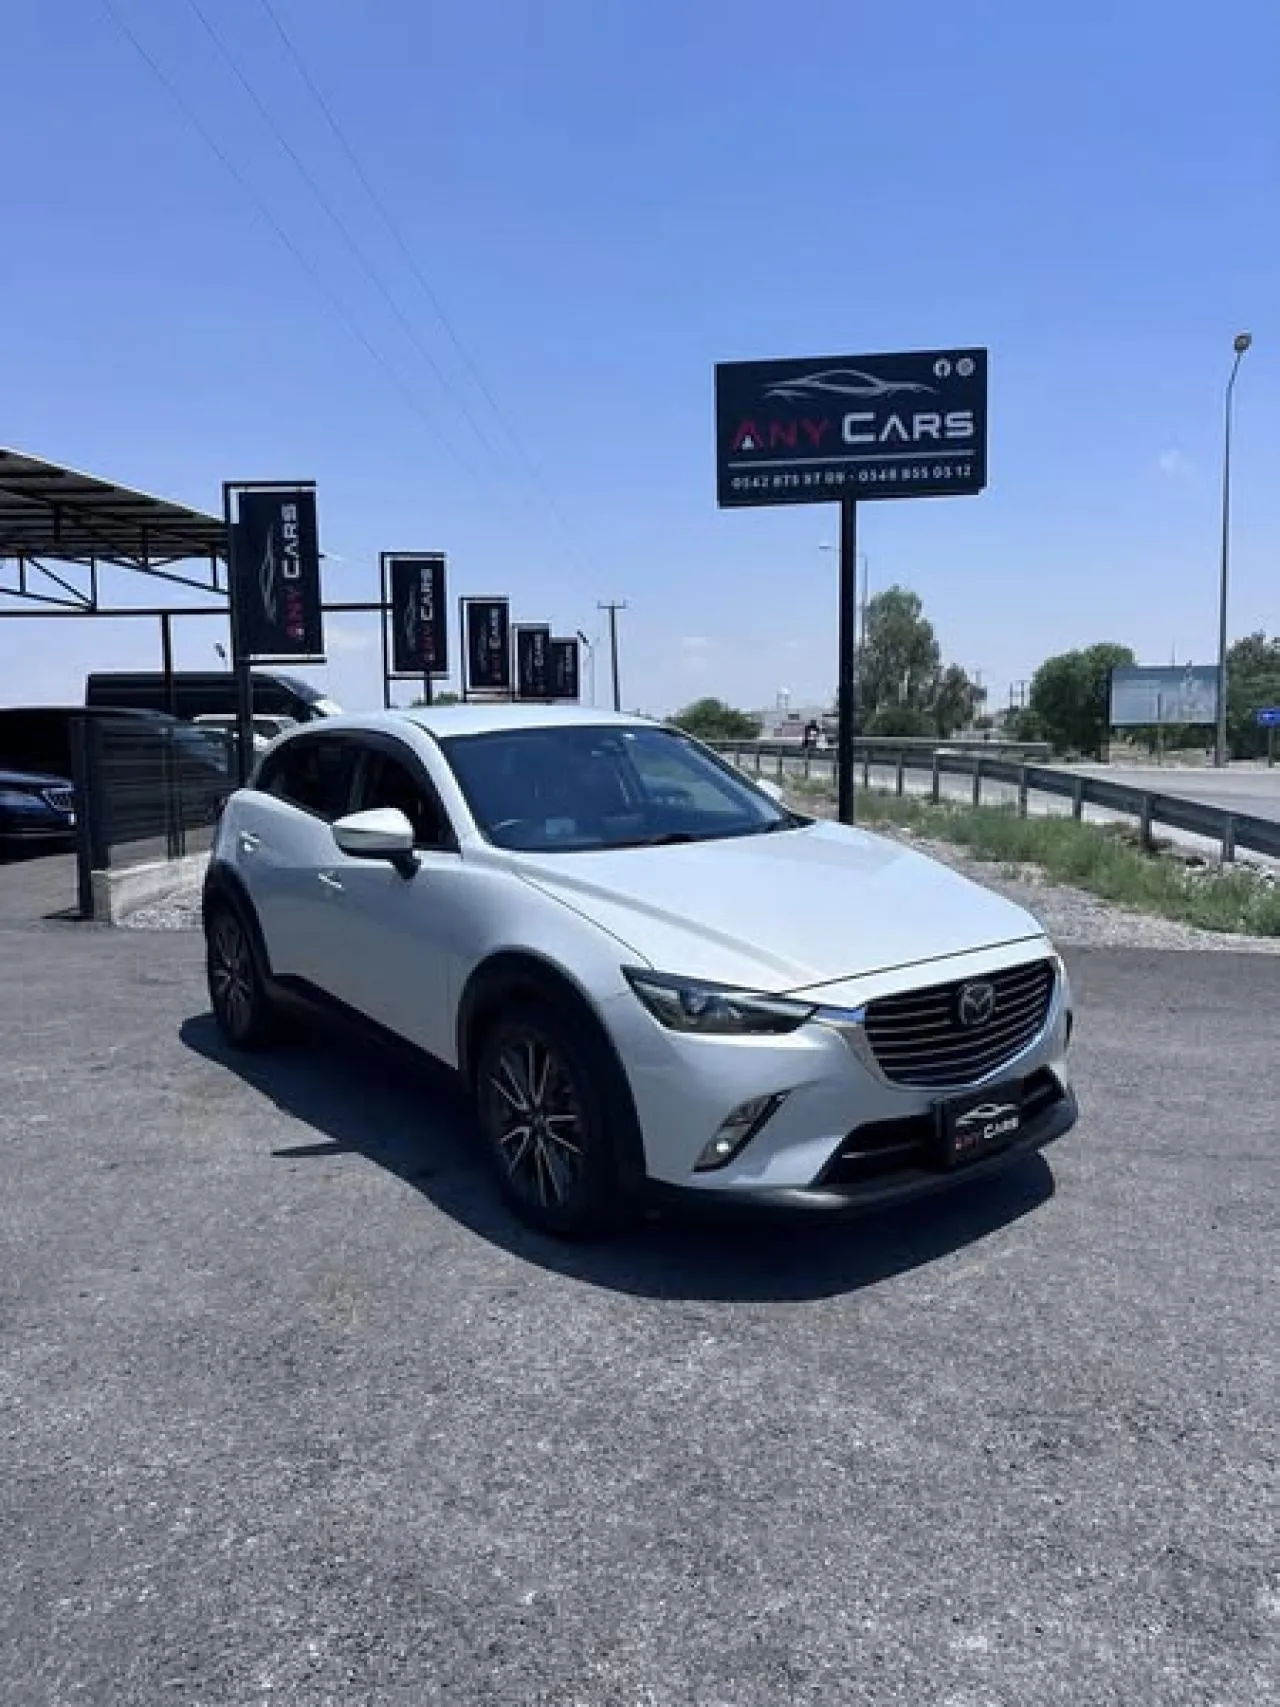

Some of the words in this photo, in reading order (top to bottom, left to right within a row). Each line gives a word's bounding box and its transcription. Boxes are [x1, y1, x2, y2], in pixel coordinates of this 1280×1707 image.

[731, 418, 829, 453] ANY
[842, 411, 975, 444] CARS
[281, 503, 300, 578] CARS
